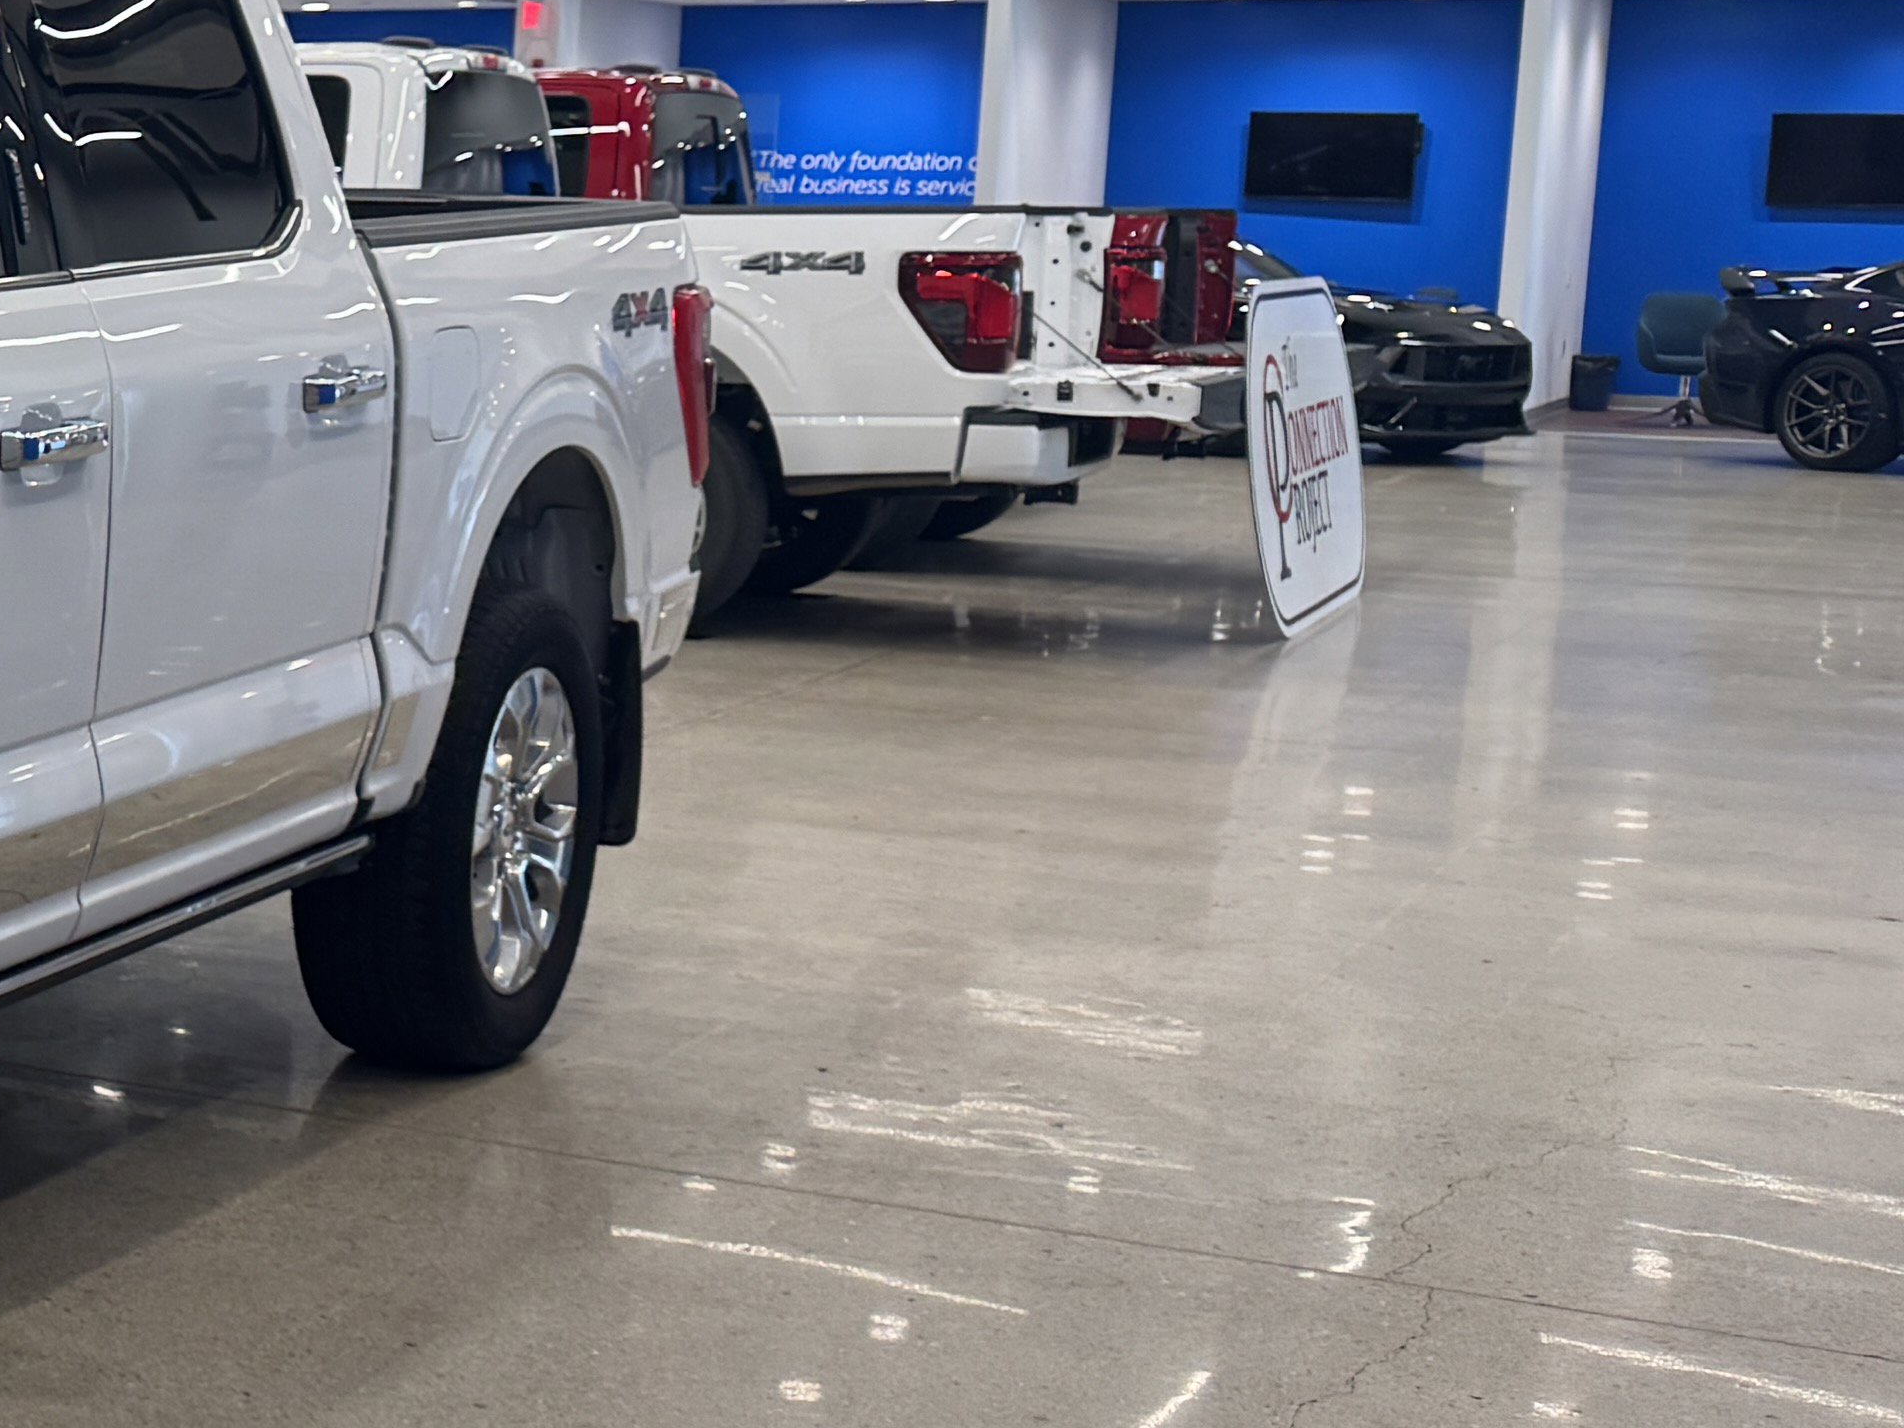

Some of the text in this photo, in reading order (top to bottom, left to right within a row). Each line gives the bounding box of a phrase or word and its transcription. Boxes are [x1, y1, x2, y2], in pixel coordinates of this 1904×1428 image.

[800, 151, 844, 173] only
[848, 150, 963, 173] foundation
[799, 173, 889, 195] business
[893, 174, 912, 195] is
